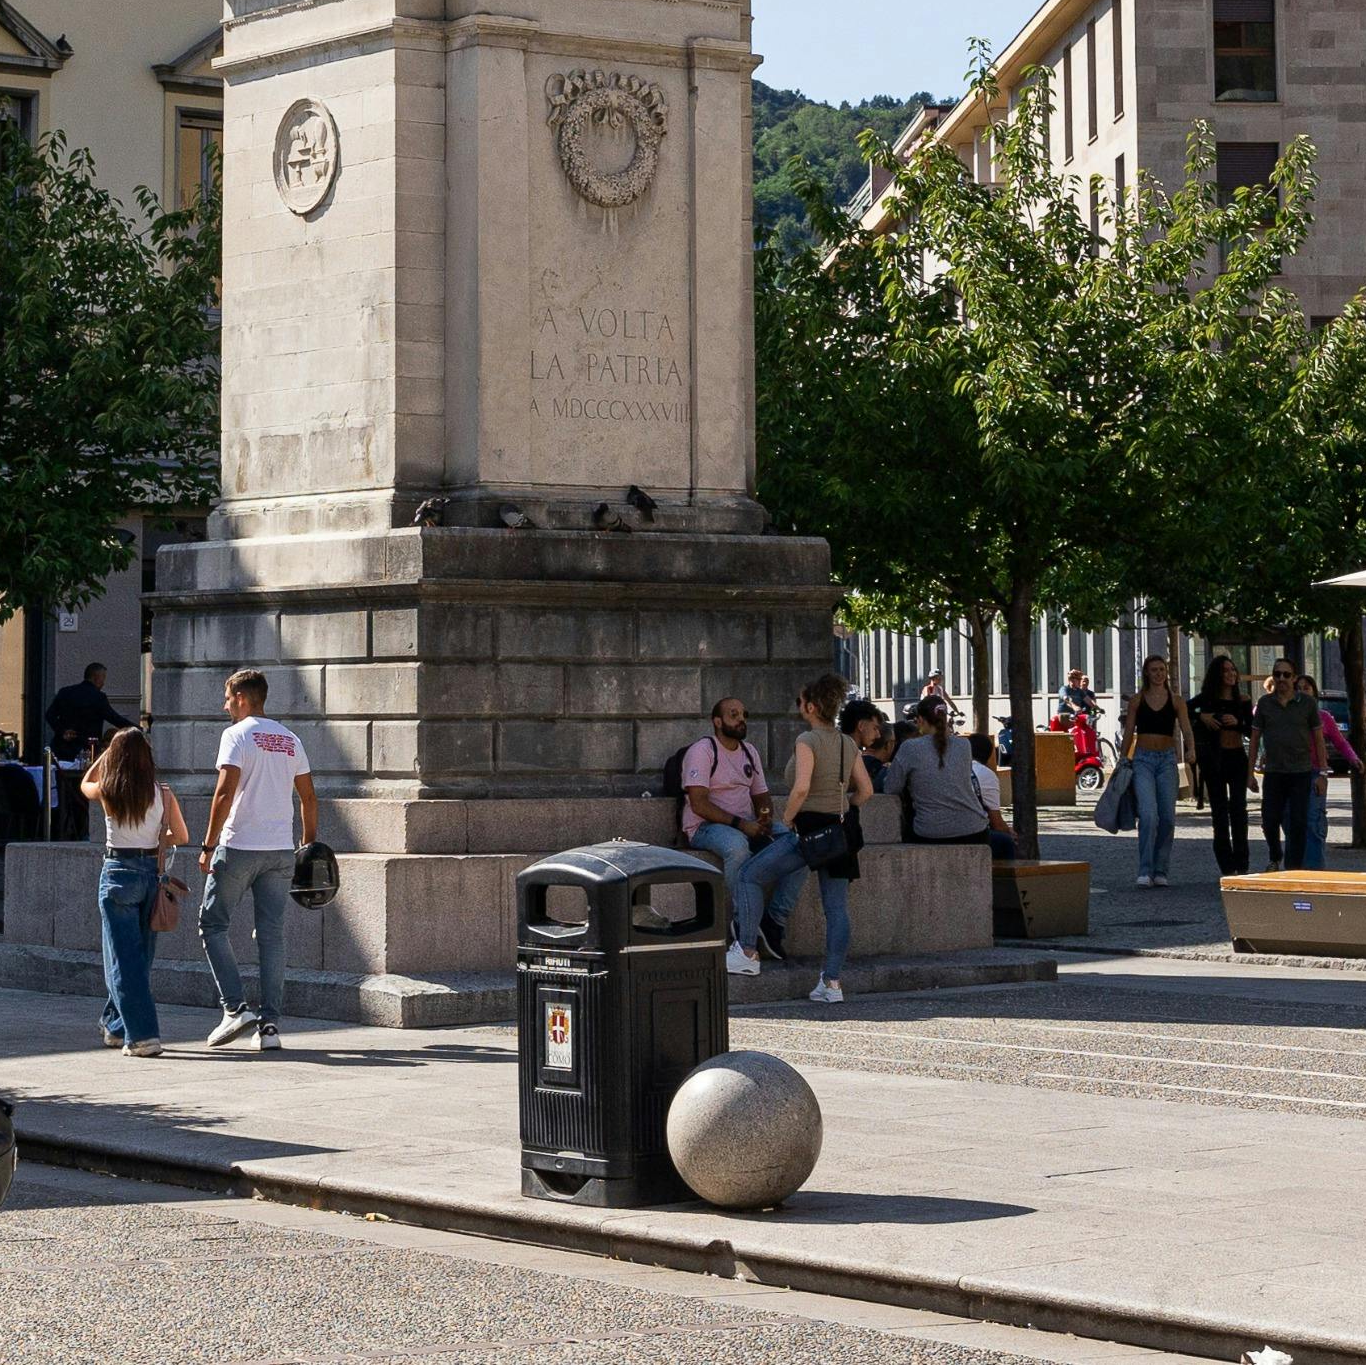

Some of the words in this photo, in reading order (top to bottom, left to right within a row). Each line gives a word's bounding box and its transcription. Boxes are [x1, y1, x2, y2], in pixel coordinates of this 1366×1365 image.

[539, 308, 558, 335] A
[578, 307, 675, 341] VOLTA
[530, 350, 565, 380] LA
[586, 353, 682, 386] PATRIA
[62, 617, 74, 627] 29
